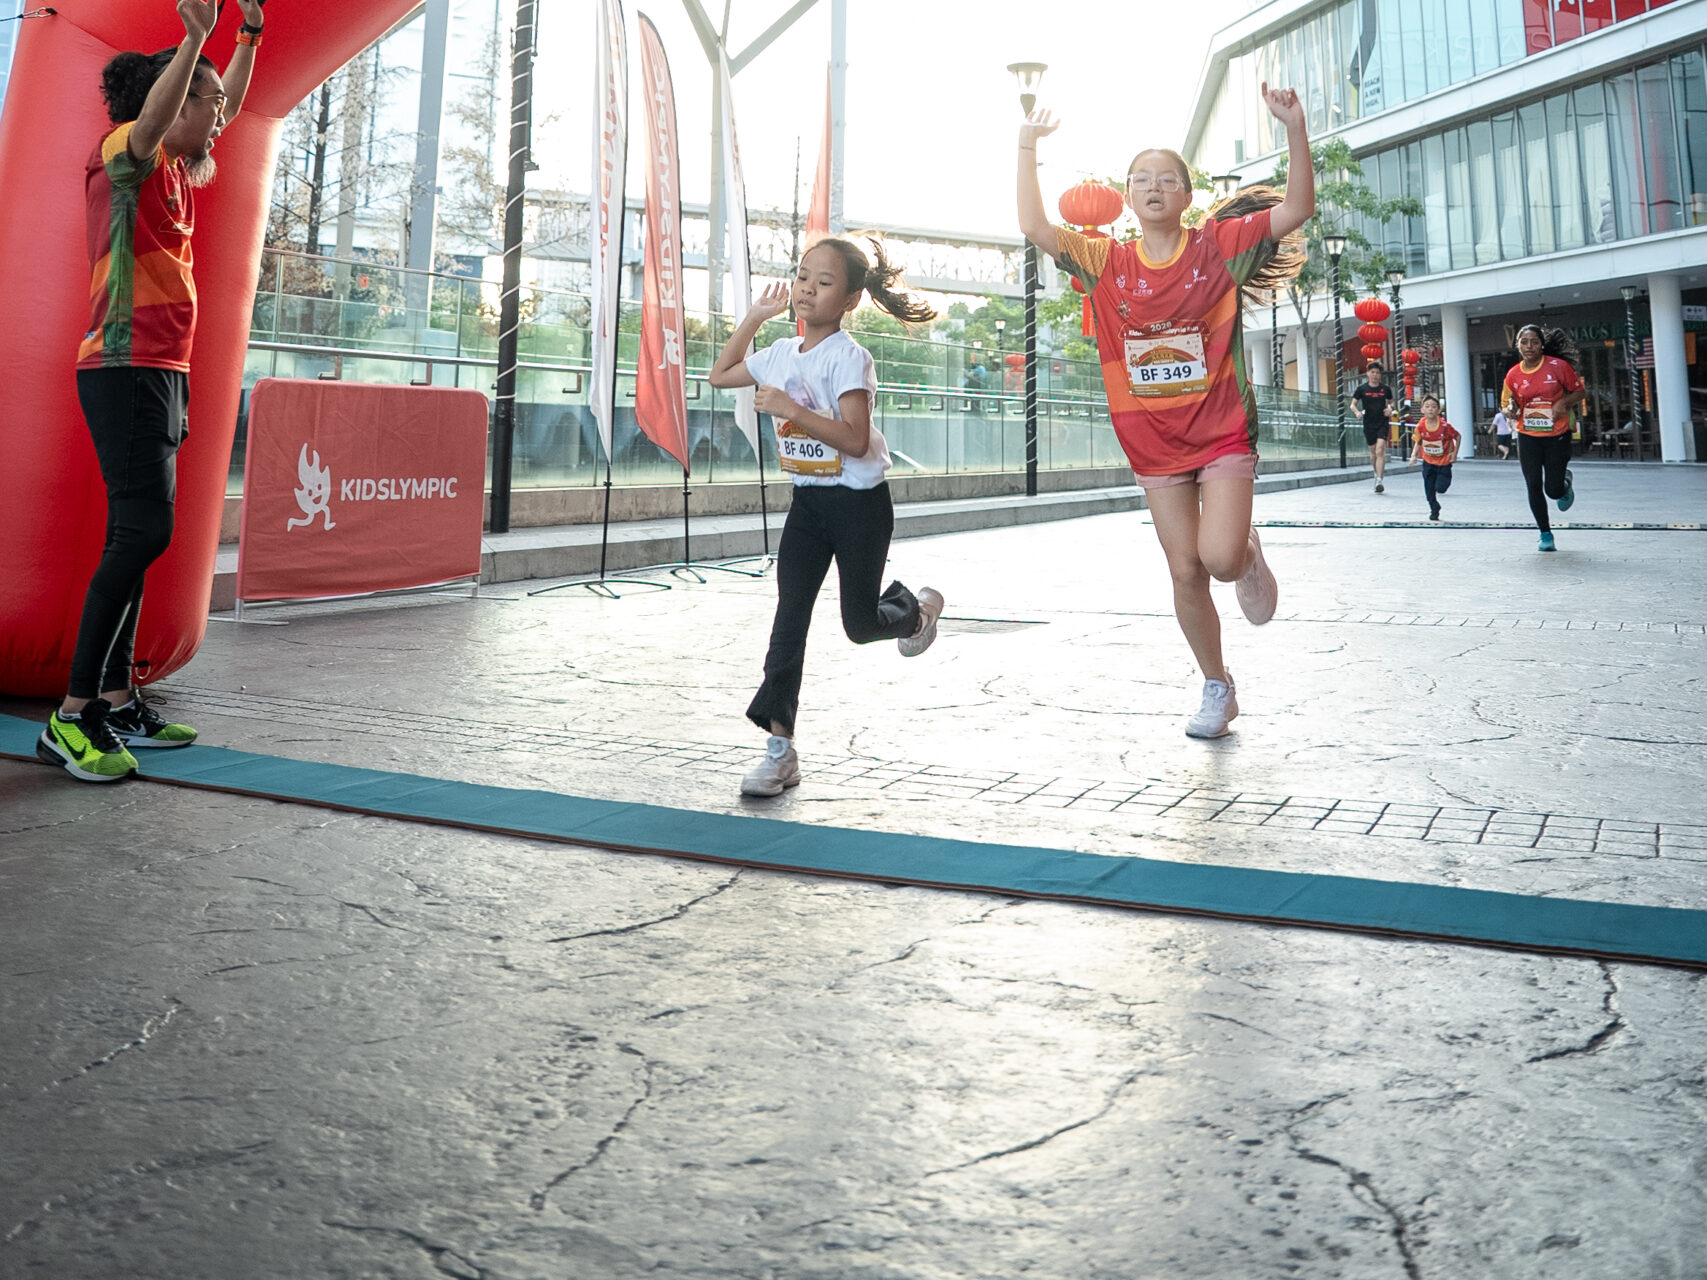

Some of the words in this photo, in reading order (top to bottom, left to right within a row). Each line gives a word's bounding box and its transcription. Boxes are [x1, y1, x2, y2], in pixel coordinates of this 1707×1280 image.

[653, 63, 676, 308] KIDSLYMPIC
[1140, 368, 1158, 381] BF
[1162, 365, 1192, 380] 349
[784, 440, 796, 456] BF
[799, 443, 824, 458] 406
[340, 477, 458, 501] KIDSLYMPIC
